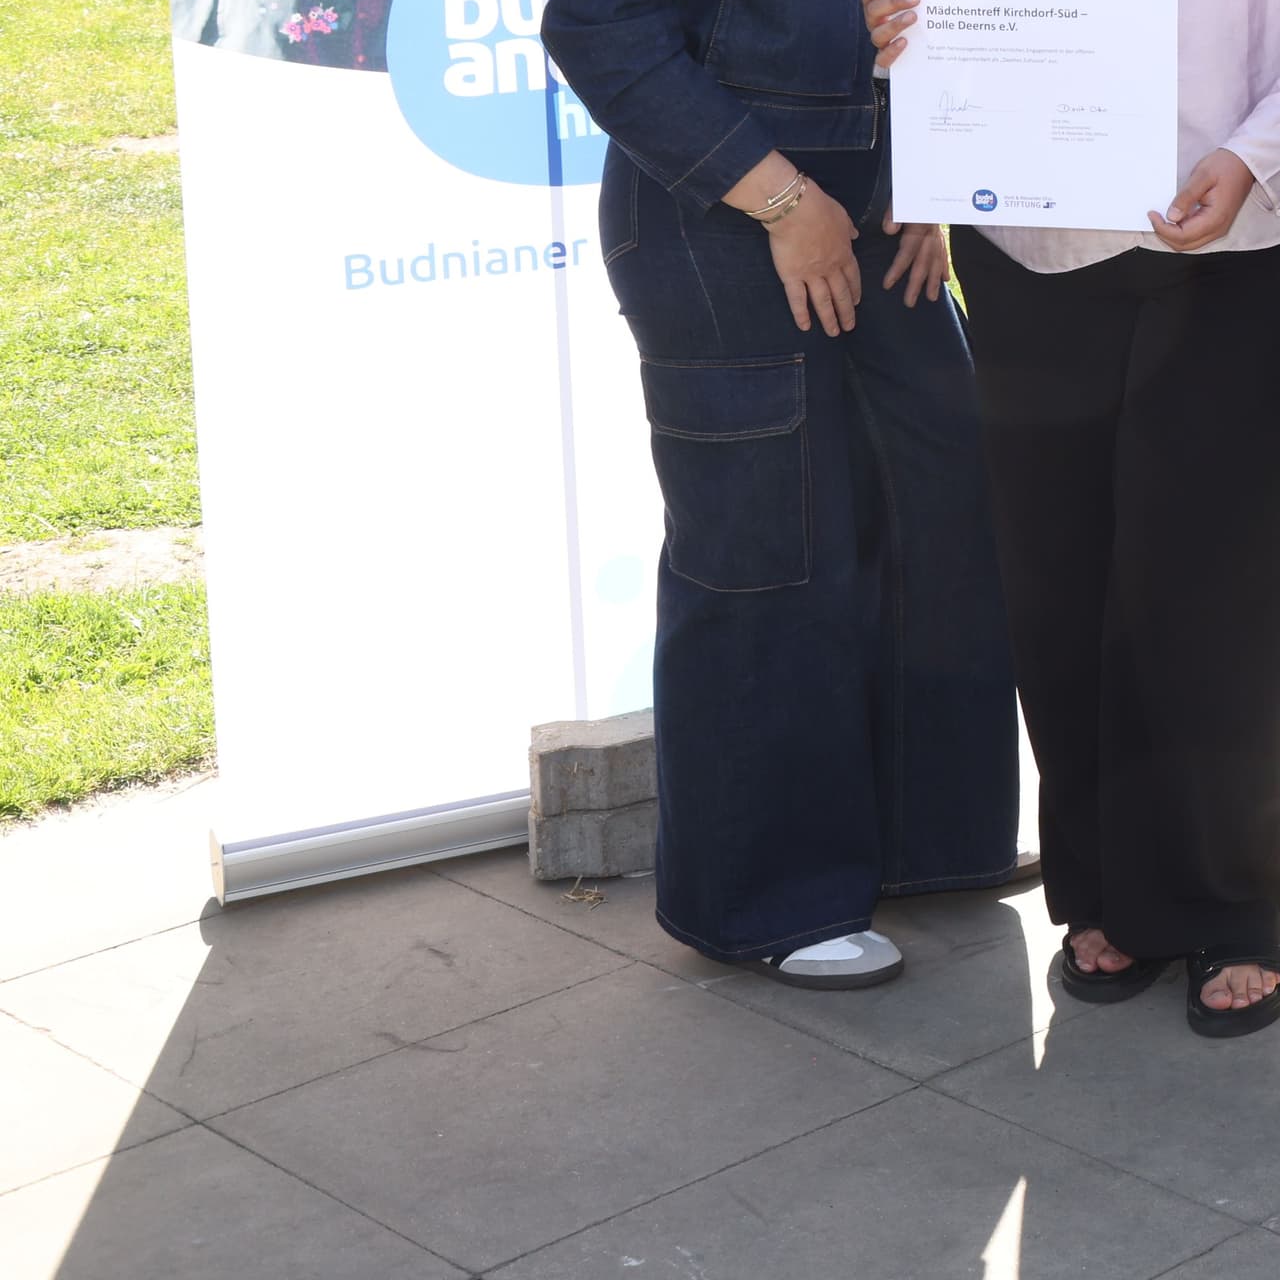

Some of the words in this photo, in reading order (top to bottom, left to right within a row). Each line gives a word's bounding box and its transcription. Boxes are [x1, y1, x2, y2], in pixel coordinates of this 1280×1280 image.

[926, 5, 1000, 18] Mädchentreff
[1003, 6, 1078, 19] Kirchdorf-Süd
[927, 20, 955, 31] Dolle
[958, 21, 996, 32] Deerns
[999, 22, 1019, 32] e.V.
[1004, 200, 1041, 209] STIFTUNG
[344, 238, 588, 291] Budnianer
